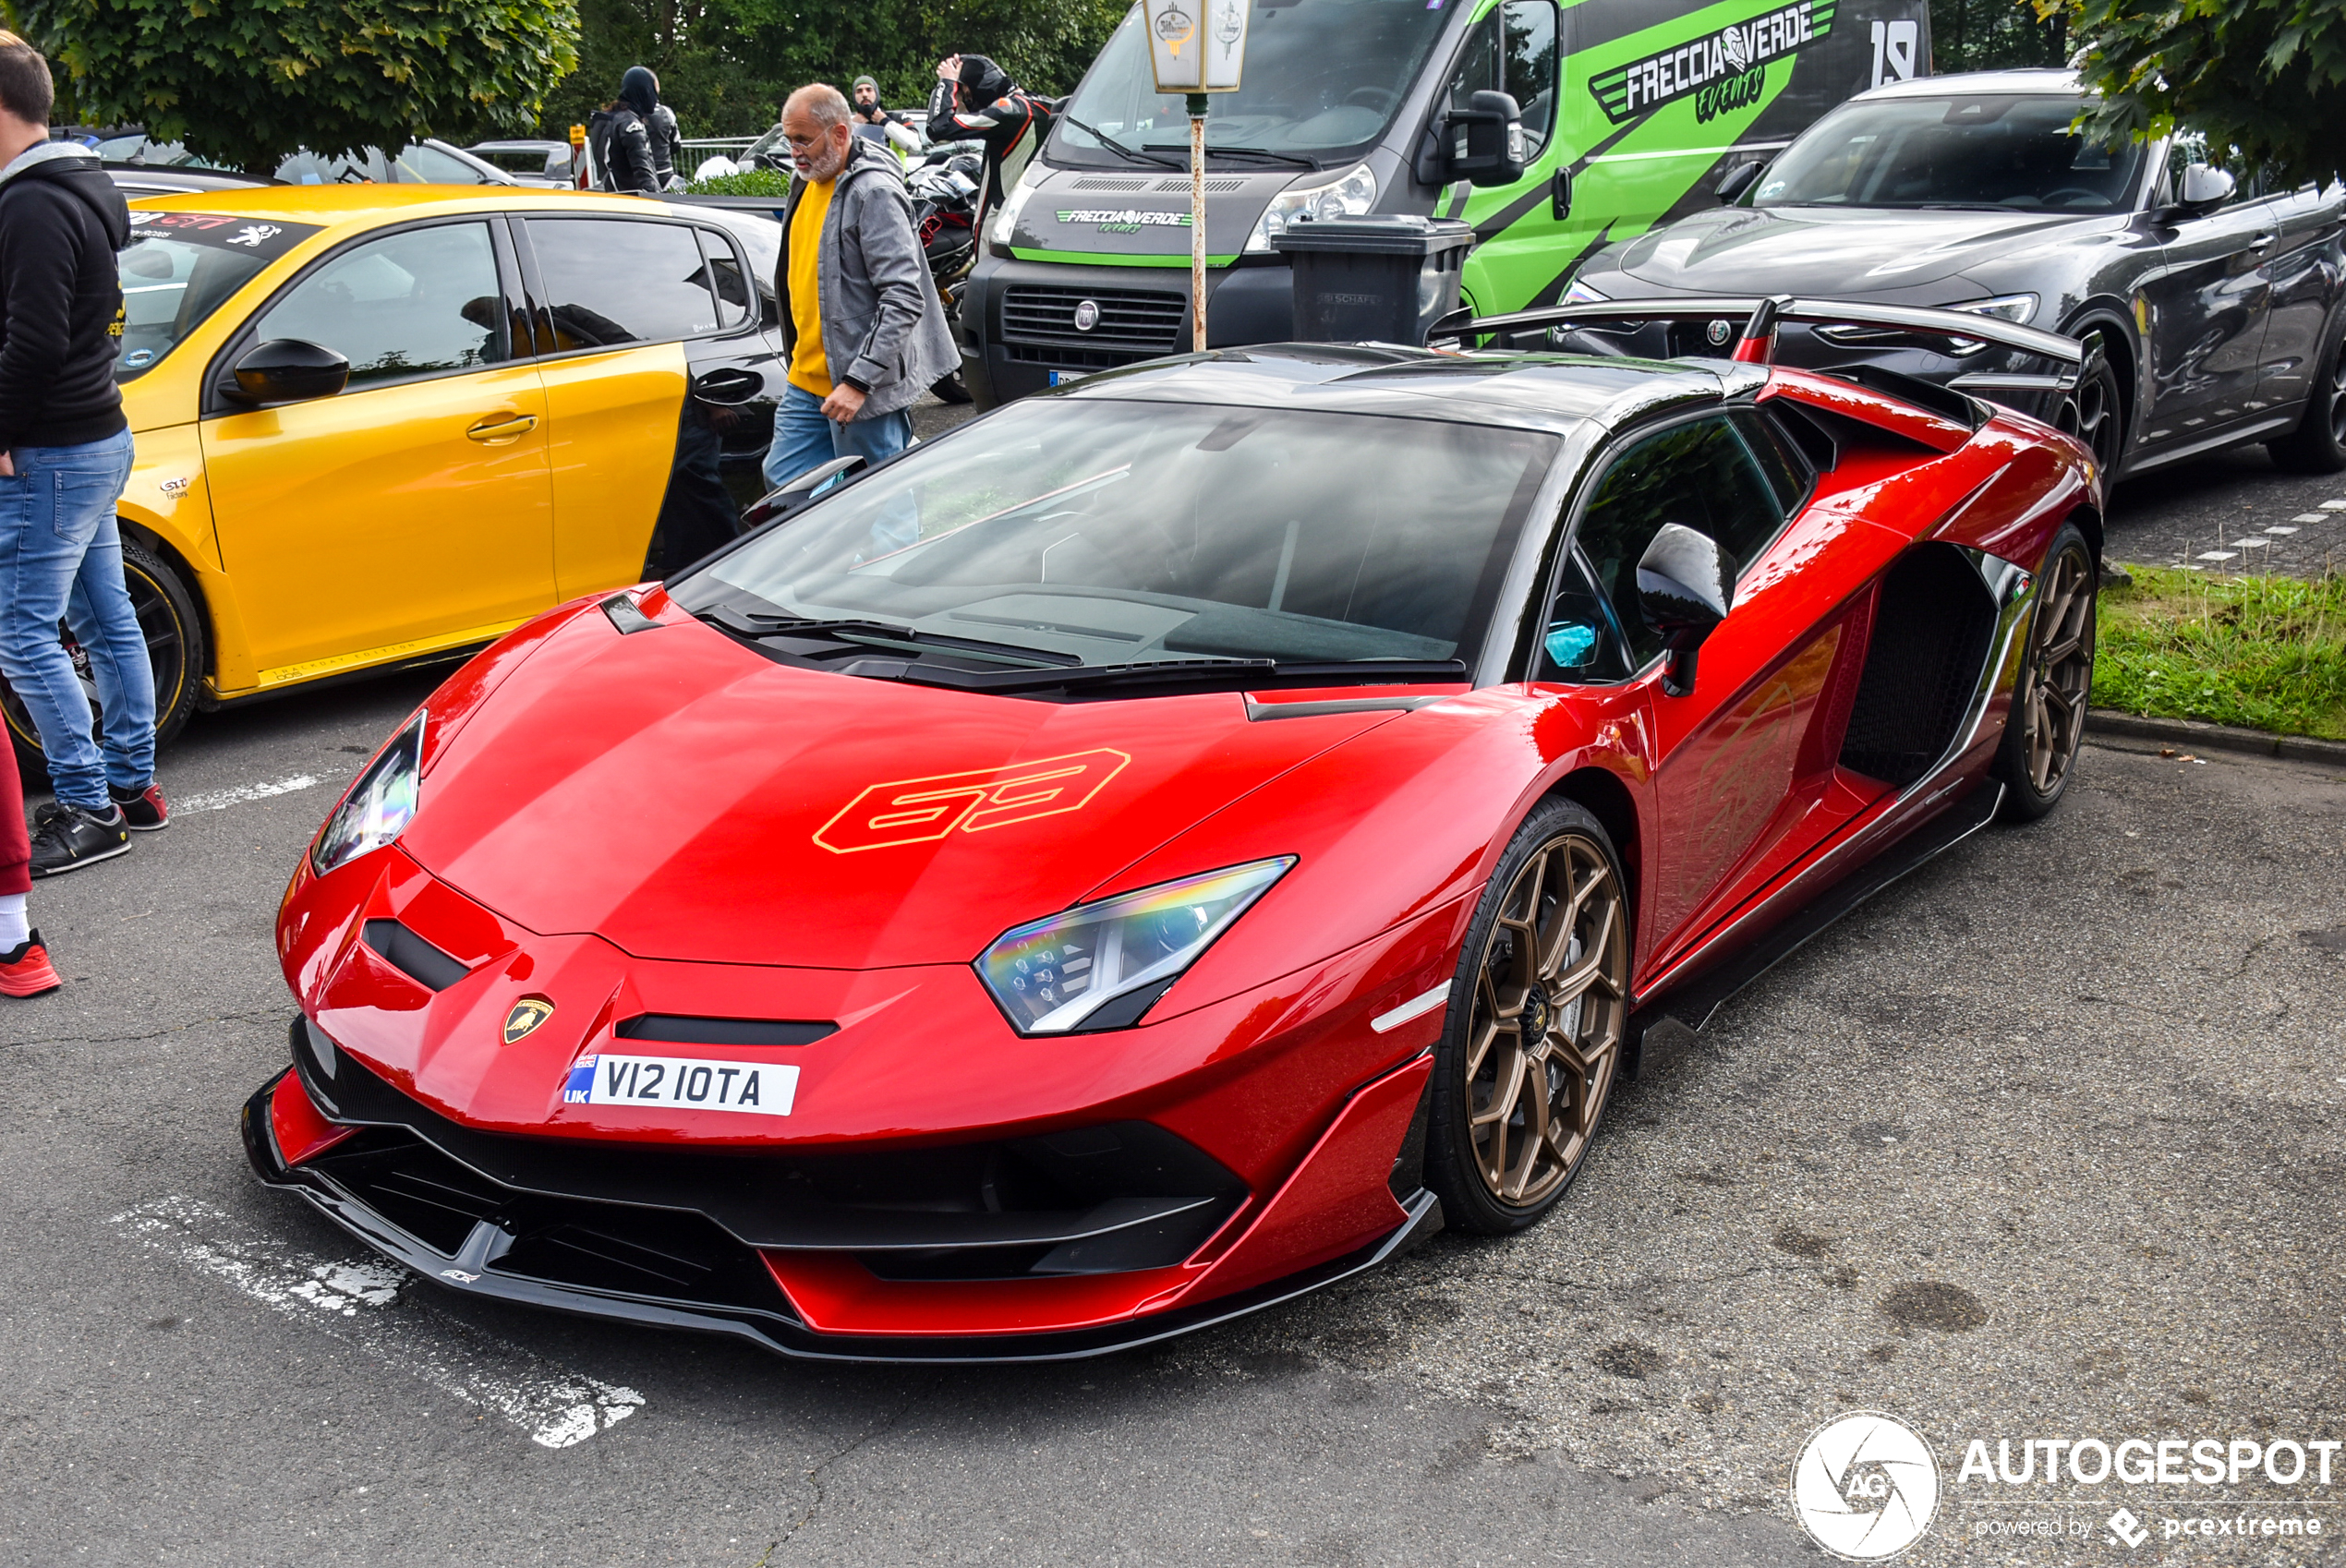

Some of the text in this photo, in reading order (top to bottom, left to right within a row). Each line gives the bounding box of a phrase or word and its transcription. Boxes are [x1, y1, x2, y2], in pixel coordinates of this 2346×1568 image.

[1626, 4, 1813, 111] FRECCIA VERDE
[1698, 66, 1764, 117] EVENTS
[1067, 211, 1185, 225] FRECCIA VERDE
[1097, 223, 1142, 234] EVENTS
[1079, 309, 1094, 323] FIAT
[272, 644, 415, 676] TRACKDAY EDITION
[609, 1061, 665, 1100] V12
[563, 1090, 589, 1104] UK
